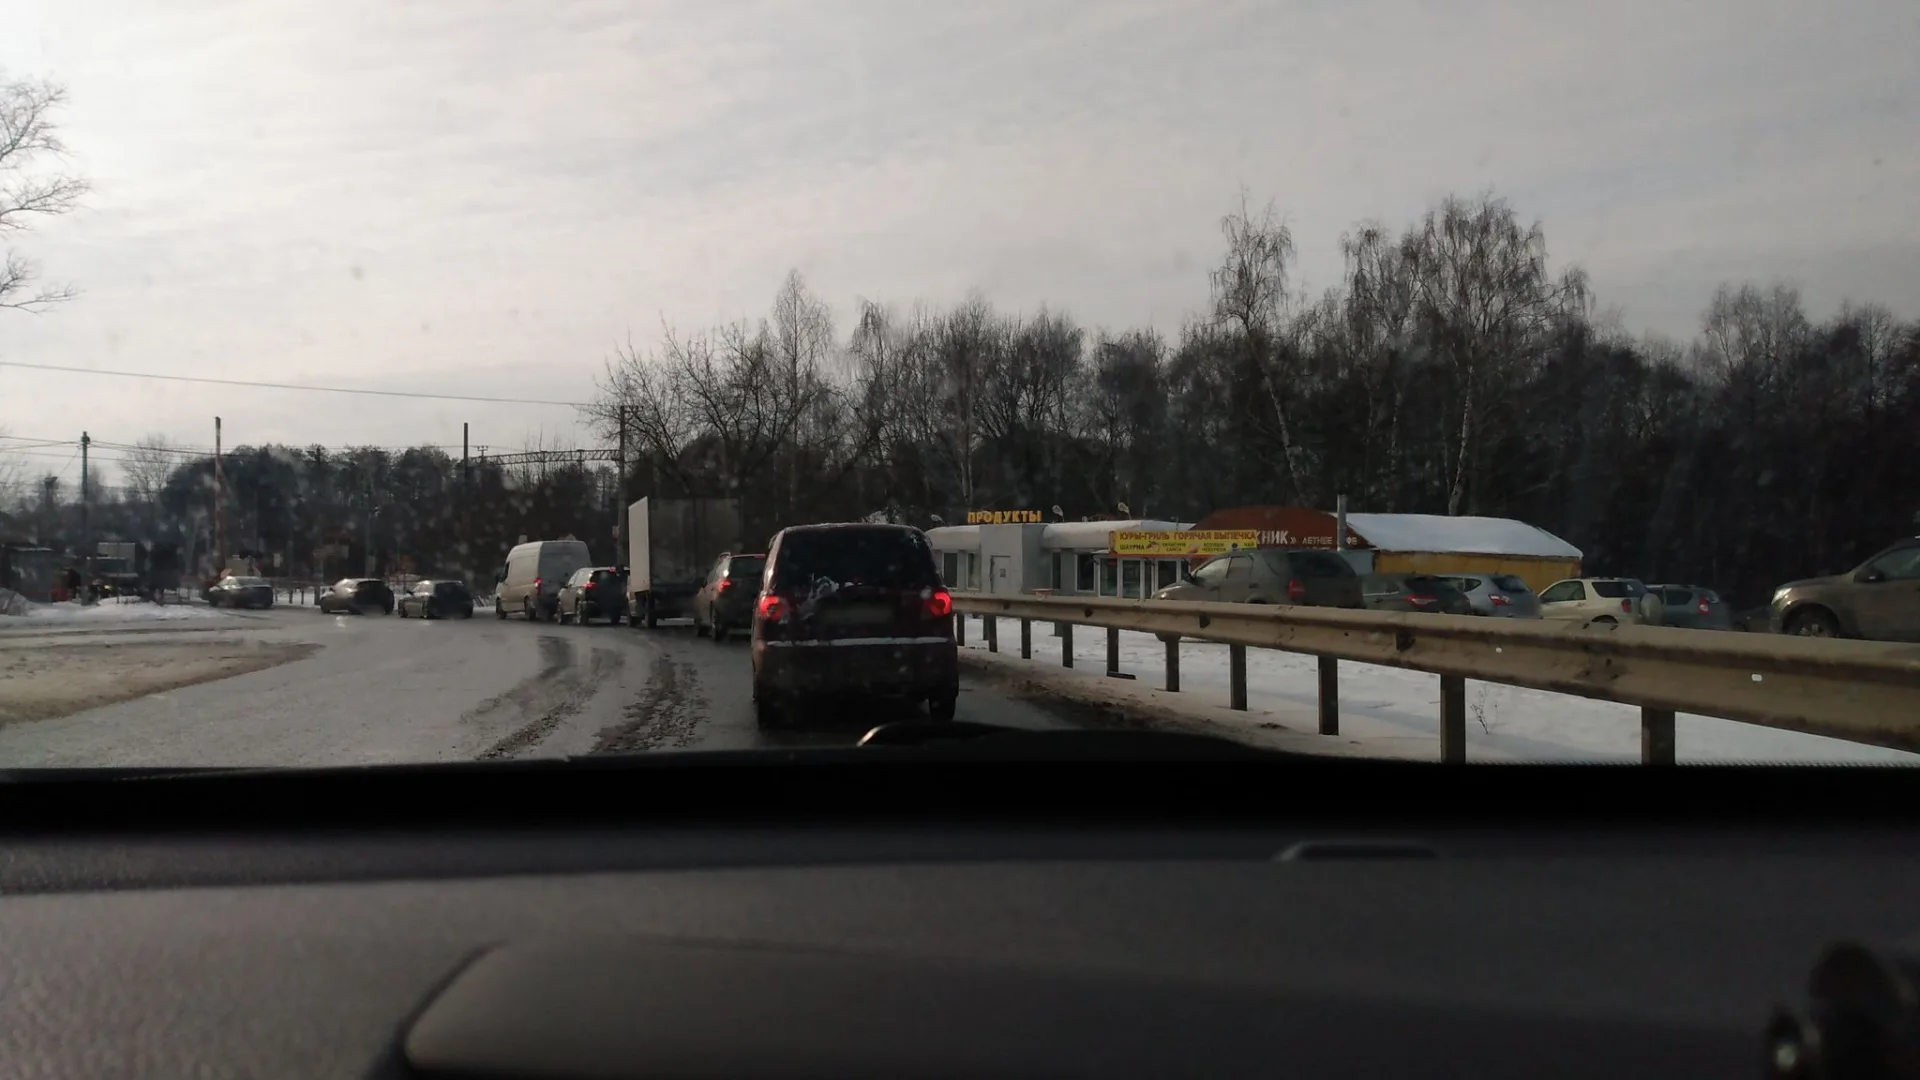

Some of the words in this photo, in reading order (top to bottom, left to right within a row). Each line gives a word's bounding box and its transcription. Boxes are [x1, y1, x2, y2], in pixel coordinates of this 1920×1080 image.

[967, 510, 1042, 524] ПРОДУКТЫ
[1119, 531, 1170, 541] КУРЫ-ГРИЛЬ
[1173, 531, 1212, 541] ГОРЯЧАЯ
[1214, 531, 1257, 540] ВЫПЕЧКА
[1302, 536, 1333, 545] ЛЕТНЕЕ
